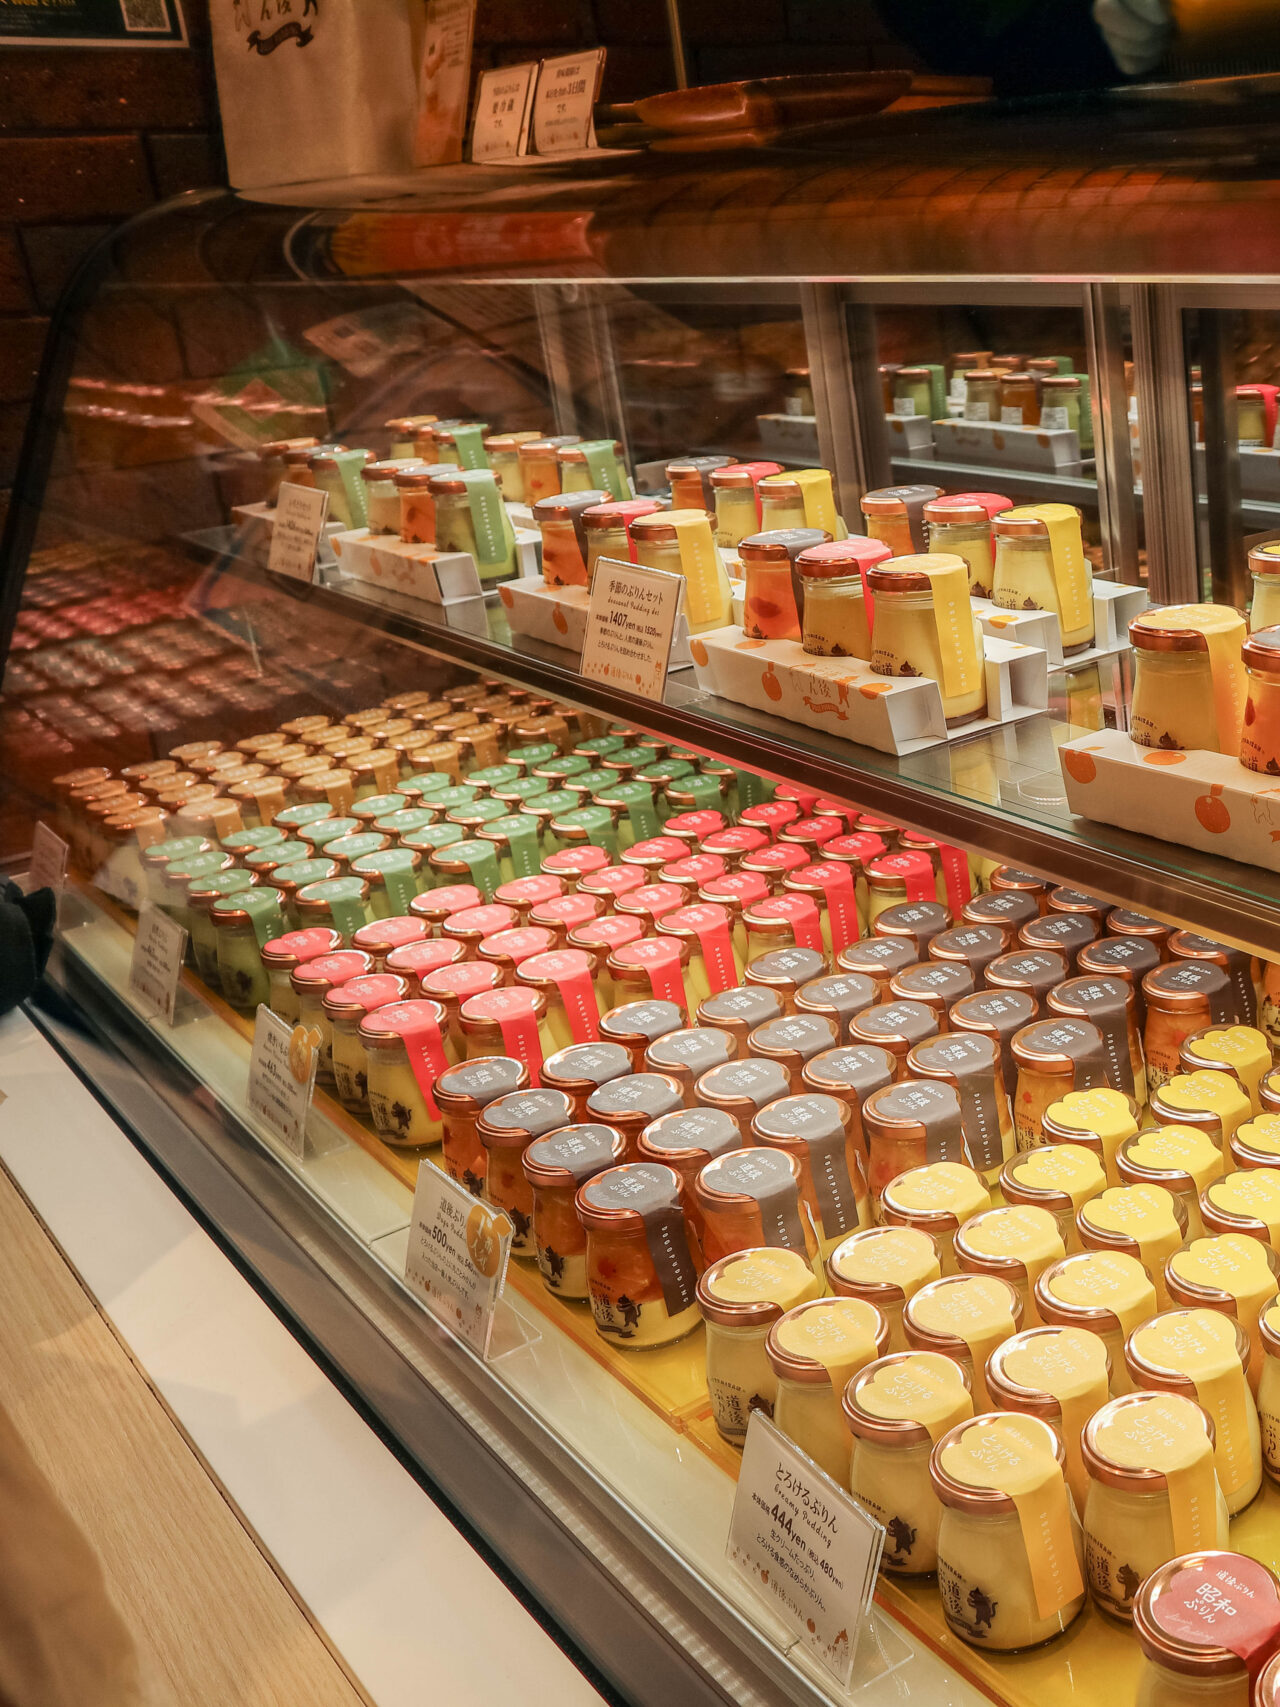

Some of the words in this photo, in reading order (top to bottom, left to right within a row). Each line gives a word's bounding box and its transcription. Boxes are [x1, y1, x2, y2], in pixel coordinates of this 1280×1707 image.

[440, 1197, 467, 1228] 道後ぷり
[432, 1225, 456, 1256] 500yen
[775, 1462, 839, 1534] とろけるぷりん
[751, 1492, 770, 1516] 本体価格
[770, 1503, 806, 1552] 444yen
[802, 1510, 832, 1550] Pudding
[770, 1579, 806, 1623] 道後ぷりん
[1195, 1582, 1237, 1617] 昭和
